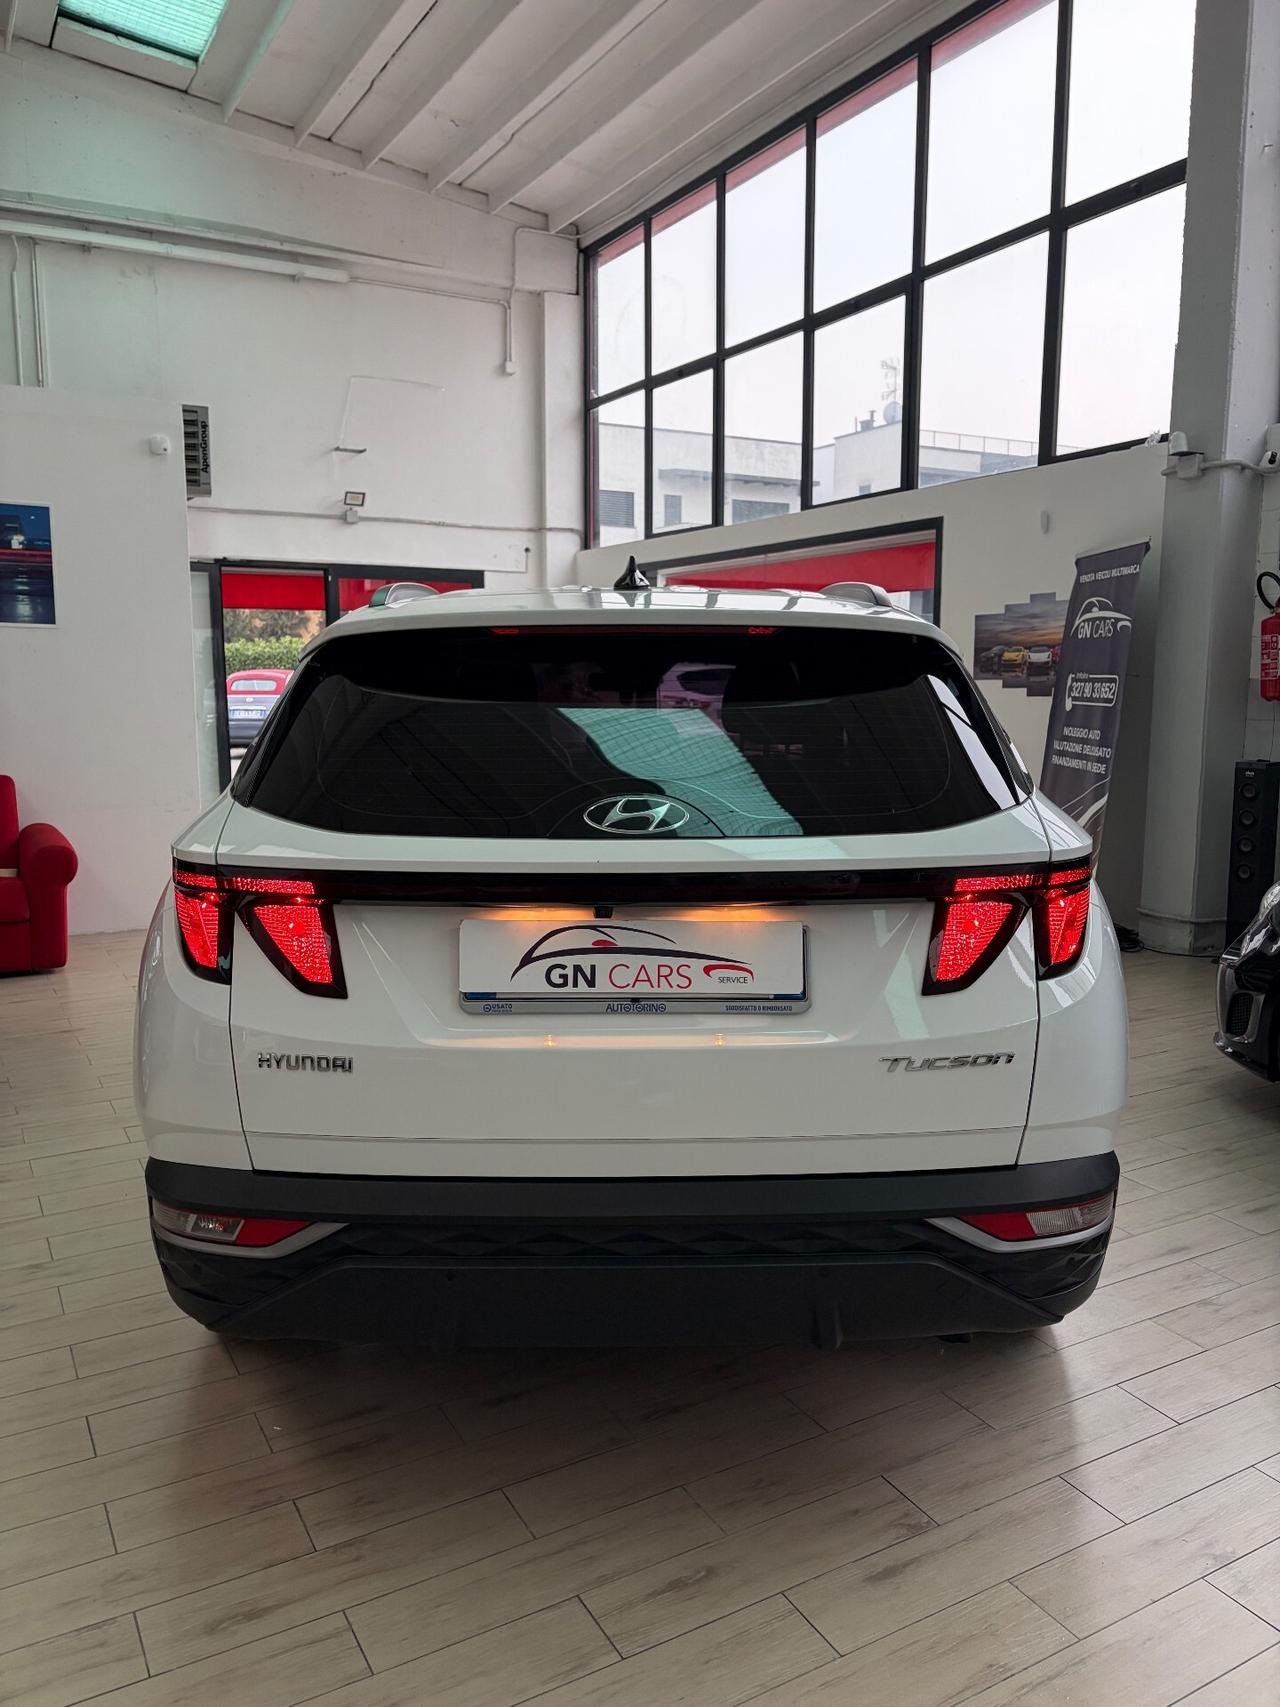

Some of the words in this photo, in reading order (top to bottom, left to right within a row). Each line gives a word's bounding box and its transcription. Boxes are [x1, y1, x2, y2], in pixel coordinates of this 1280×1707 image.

[200, 420, 210, 474] ApenGroup
[1078, 621, 1092, 639] GN
[1093, 618, 1115, 638] CARS
[545, 963, 597, 989] GN
[608, 963, 693, 990] CARS
[717, 975, 749, 985] SERVICE
[605, 1002, 667, 1013] AUTOTORINO
[258, 1052, 353, 1073] HYUNDAI
[880, 1052, 1015, 1072] TUCSON
